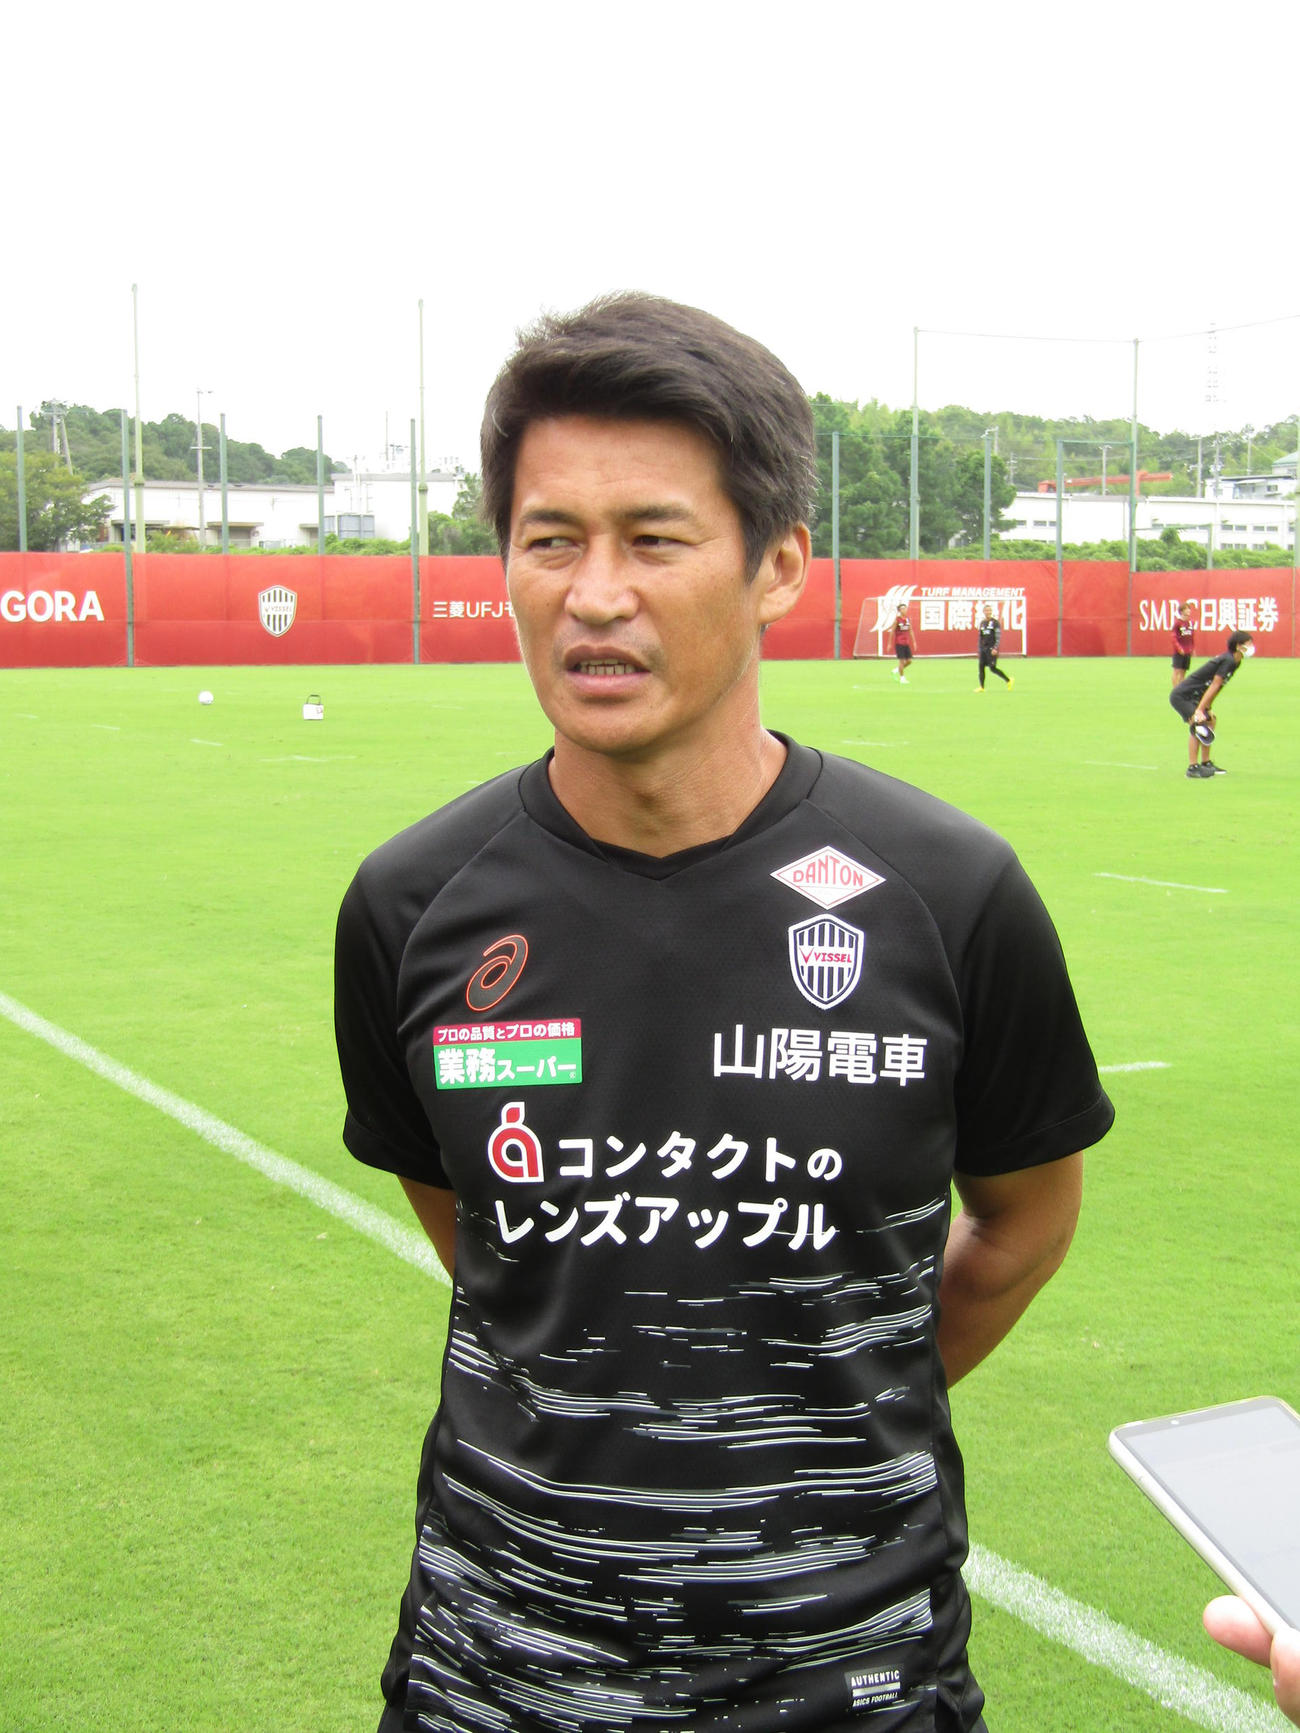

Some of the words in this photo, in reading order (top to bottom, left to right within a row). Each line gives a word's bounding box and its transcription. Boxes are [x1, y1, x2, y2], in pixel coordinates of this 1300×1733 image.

[0, 590, 105, 622] GORA
[921, 587, 949, 597] TURF
[951, 587, 1025, 597] MANAGEMENT
[793, 855, 864, 887] DANTON
[814, 952, 853, 963] VISSEL
[438, 1022, 576, 1043] プロの品質とプロの価格
[438, 1047, 577, 1085] 業務スーパー
[713, 1023, 928, 1087] 山陽電車
[558, 1130, 843, 1183] コンタクトの
[495, 1191, 837, 1251] レンズアップル
[851, 1669, 900, 1688] AUTHENTIC
[852, 1697, 871, 1708] ASICS
[871, 1691, 898, 1704] FOOTBALL
